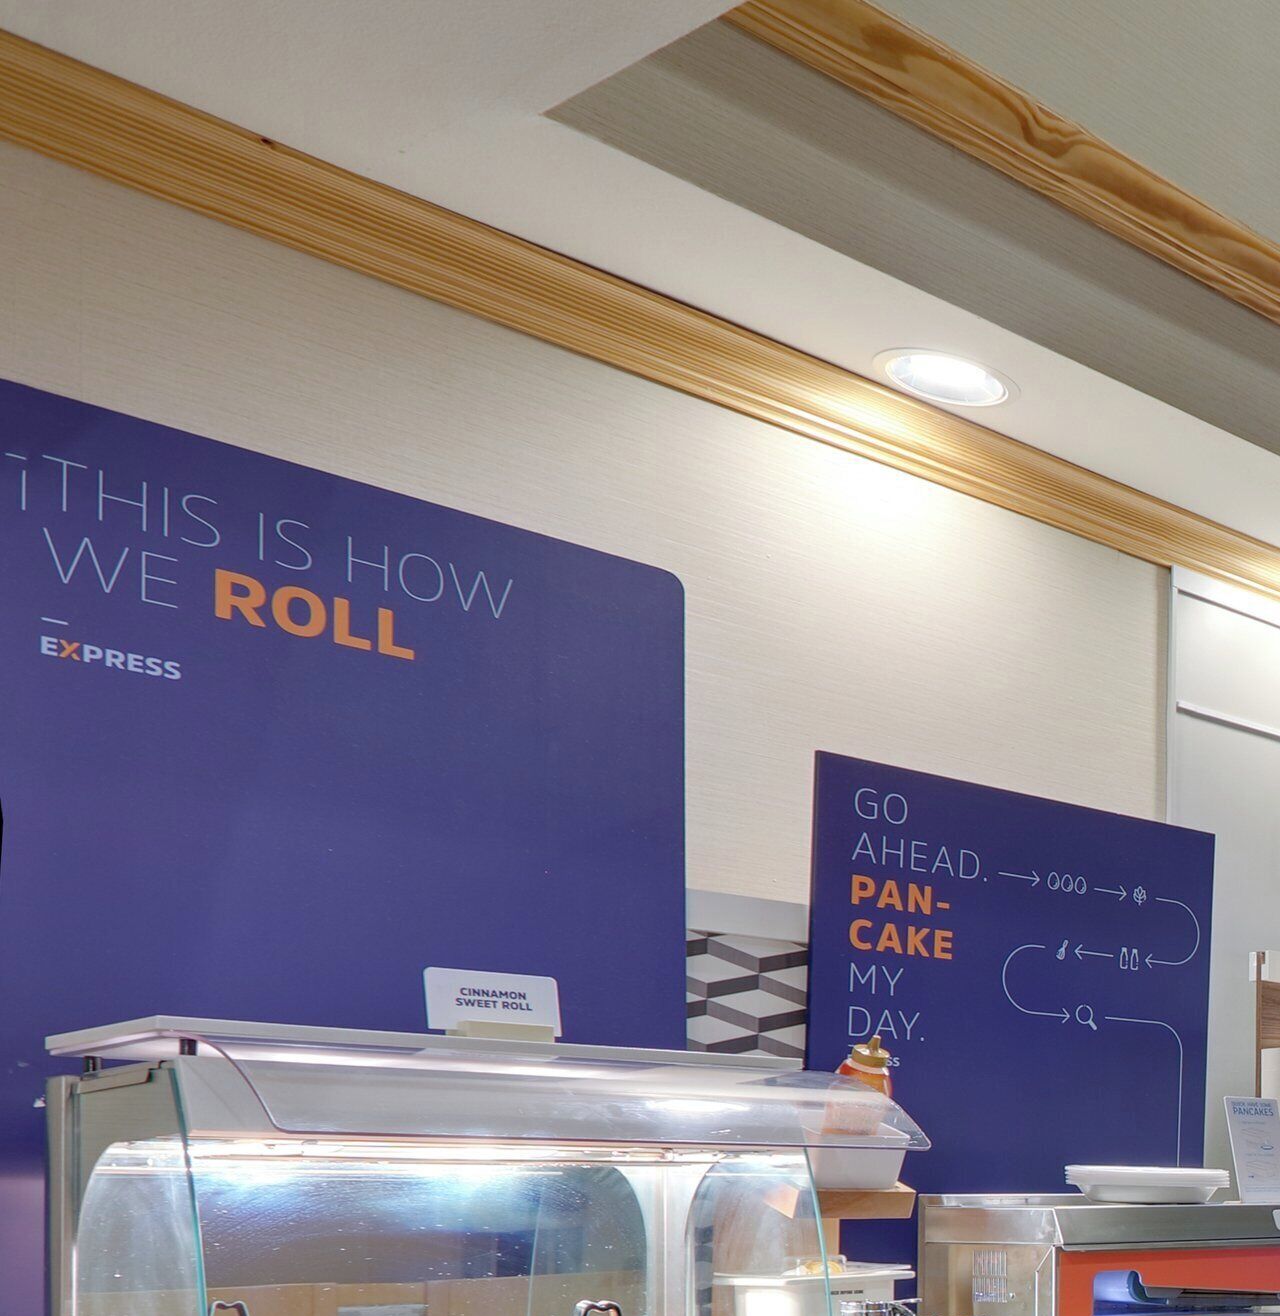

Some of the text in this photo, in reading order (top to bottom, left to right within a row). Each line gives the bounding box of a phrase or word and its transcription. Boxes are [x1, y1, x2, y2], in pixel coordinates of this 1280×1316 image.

[259, 513, 312, 570] IS
[347, 536, 513, 618] HOW
[43, 527, 415, 660] WE ROLL
[41, 635, 181, 680] EXPRESS
[854, 788, 908, 825] GO
[851, 832, 988, 882] AHEAD.
[851, 874, 950, 915] PAN-
[849, 919, 953, 960] CAKE
[460, 987, 526, 1000] CINNAMON
[849, 962, 903, 996] MY
[455, 998, 533, 1011] SWEET ROLL
[848, 1005, 924, 1041] DAY.
[1233, 1107, 1274, 1117] PANCAKES
